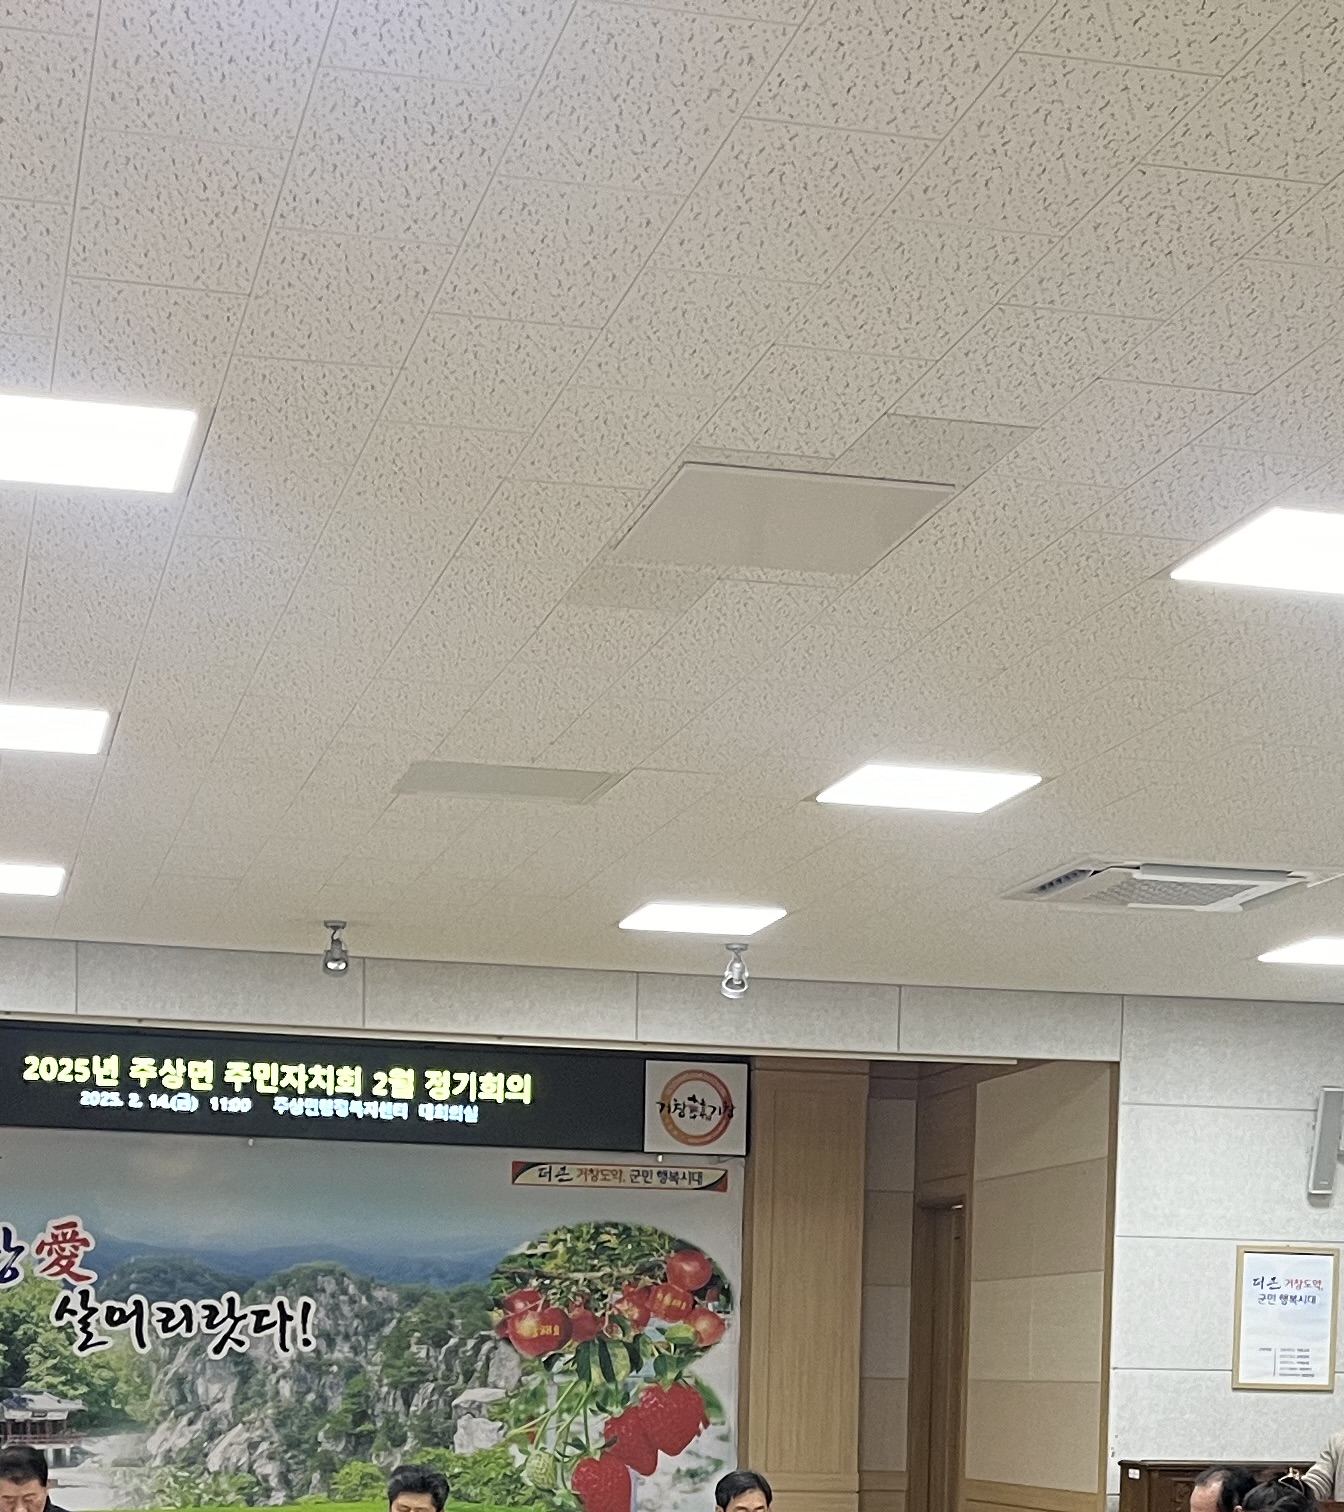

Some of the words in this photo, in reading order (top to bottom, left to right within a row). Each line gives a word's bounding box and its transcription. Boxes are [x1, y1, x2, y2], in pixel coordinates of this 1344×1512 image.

[22, 1054, 120, 1088] 2025년
[128, 1057, 215, 1092] 주상면
[223, 1060, 364, 1098] 주민자치회
[371, 1067, 416, 1100] 2월
[423, 1070, 533, 1105] 정기회의
[629, 1168, 654, 1186] 군민
[656, 1168, 705, 1187] 행복시대
[1257, 1292, 1277, 1306] 군민
[54, 1288, 316, 1356] 살어리랏다!
